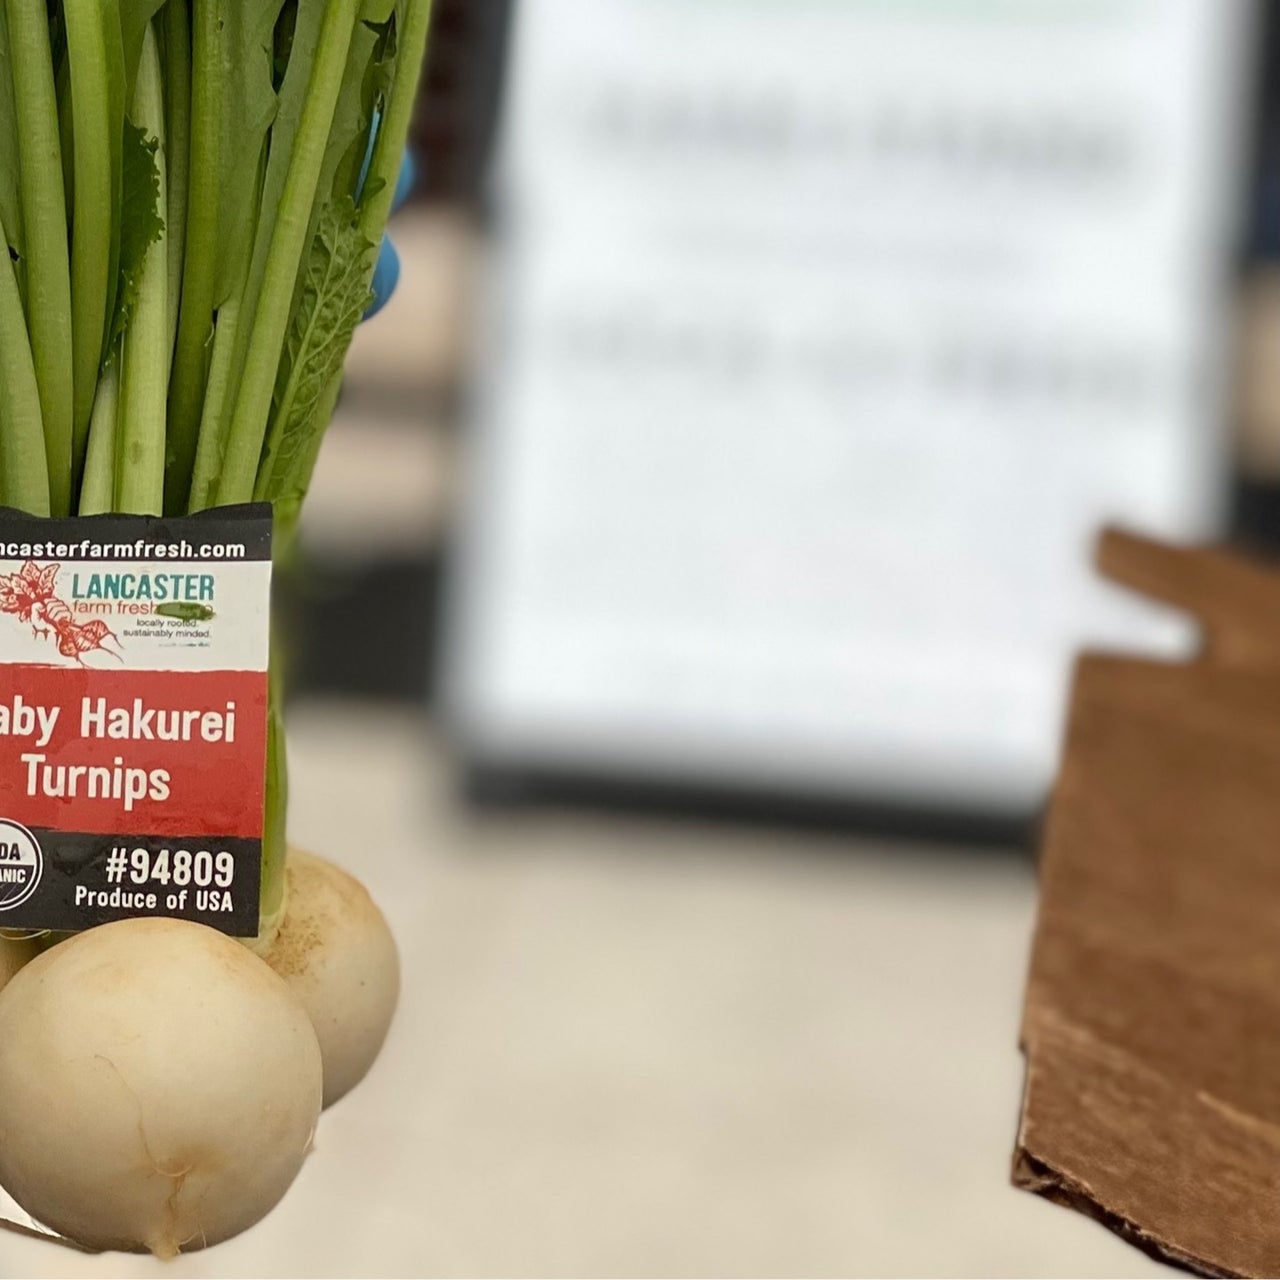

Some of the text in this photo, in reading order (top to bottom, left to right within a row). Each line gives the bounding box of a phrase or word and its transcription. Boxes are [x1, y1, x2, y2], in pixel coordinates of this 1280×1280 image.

[72, 573, 215, 601] LANCASTER
[73, 600, 112, 615] farm
[123, 628, 173, 639] sustainably
[136, 618, 165, 628] locally
[80, 697, 235, 743] Hakurei
[20, 753, 171, 811] Turnips
[105, 847, 235, 887] #94809
[74, 885, 234, 913] Produce of USA
